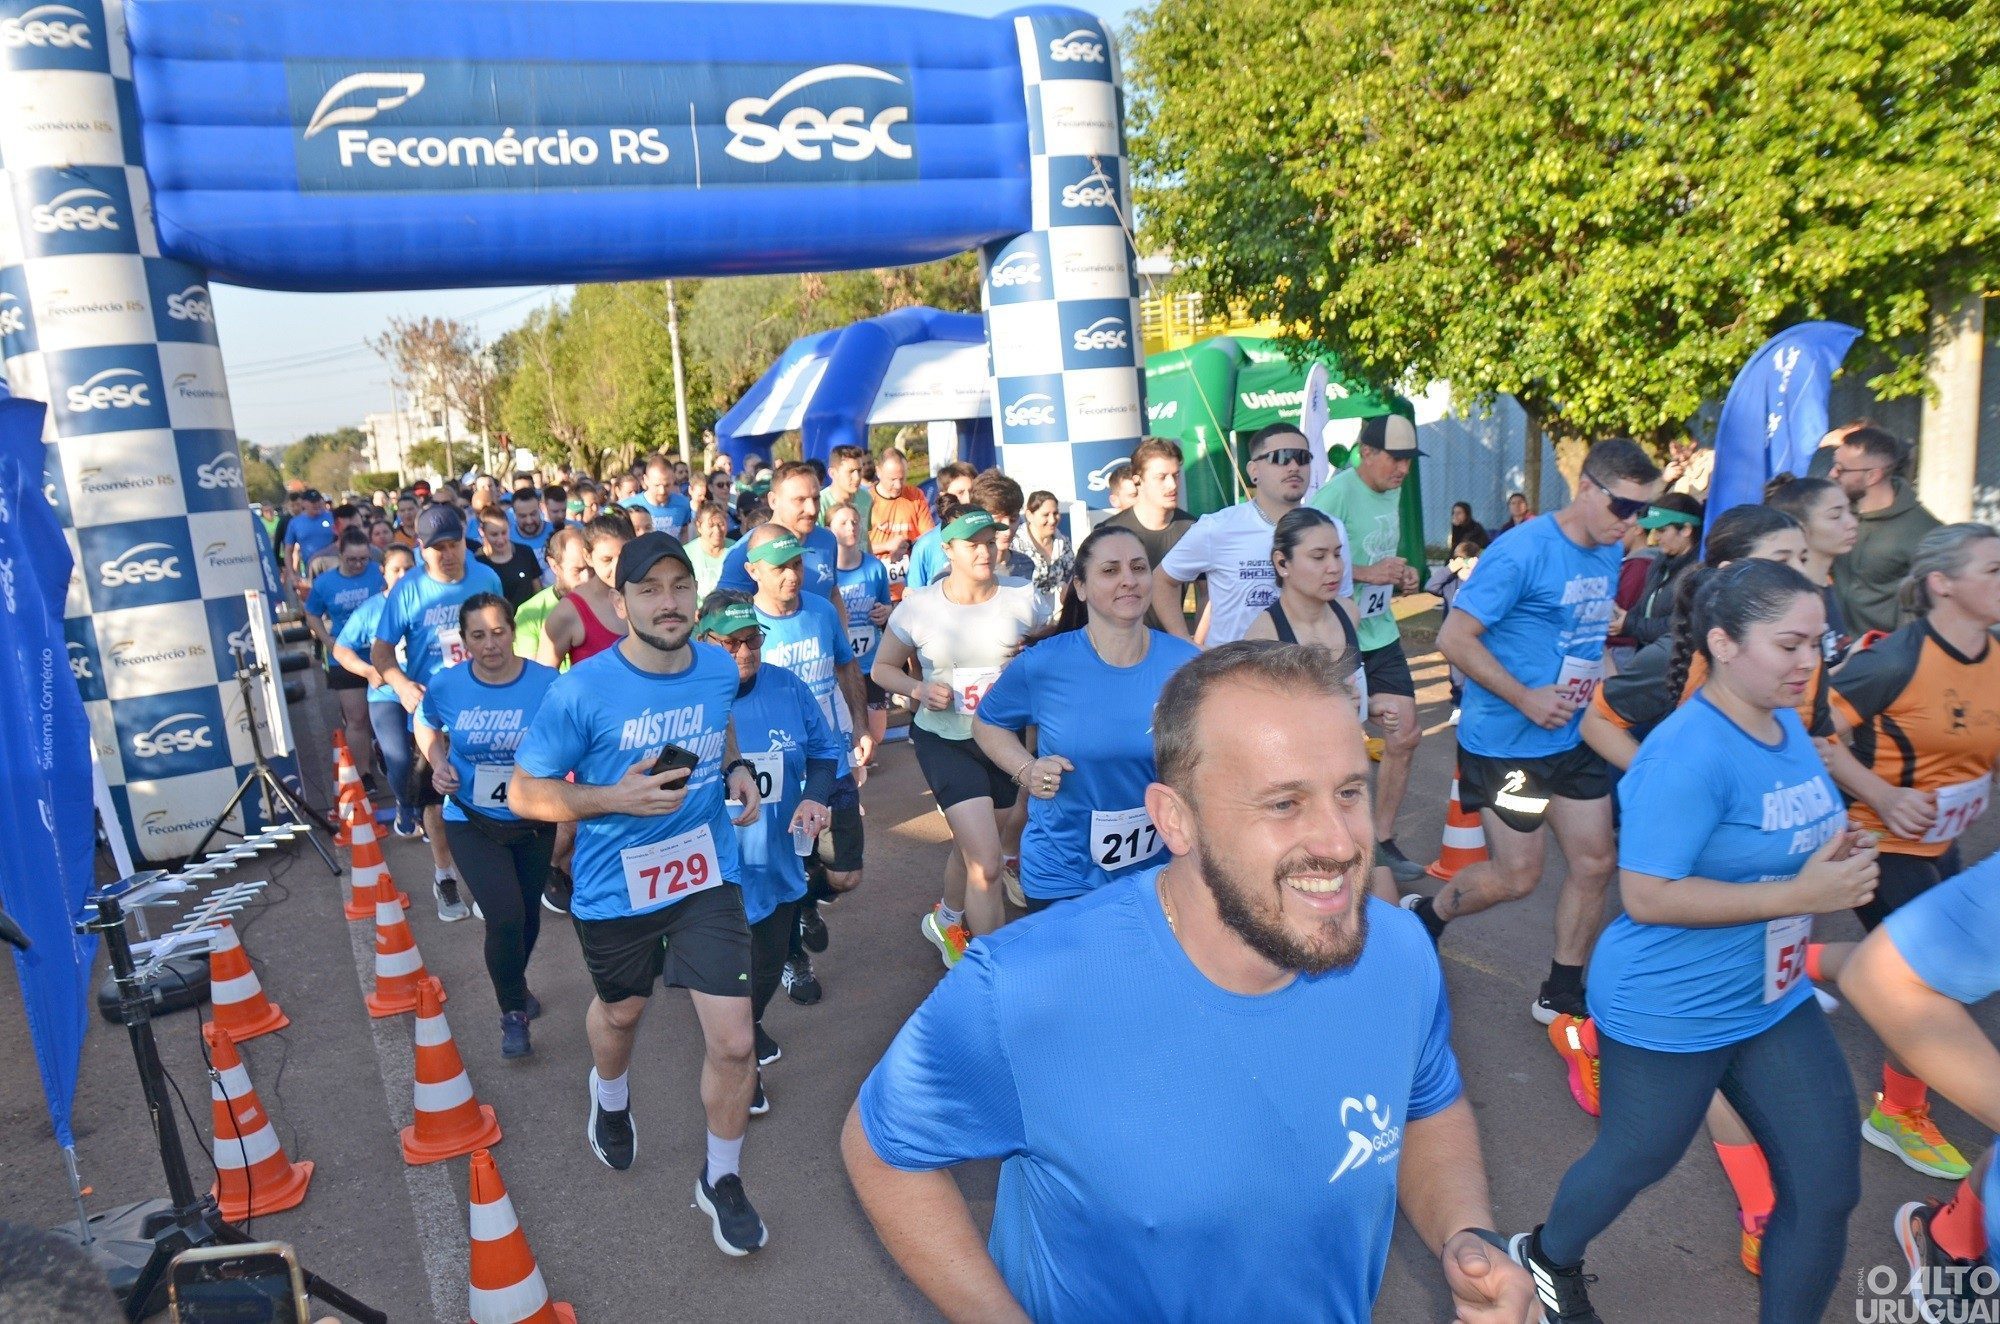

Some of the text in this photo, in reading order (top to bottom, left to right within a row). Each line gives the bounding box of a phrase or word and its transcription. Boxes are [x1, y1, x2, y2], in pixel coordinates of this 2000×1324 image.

[0, 19, 92, 49] Sesc
[1050, 38, 1105, 63] Sesc
[337, 95, 913, 167] Fecomércio RS Sesc
[32, 204, 119, 234] Sesc
[991, 262, 1042, 288] Sesc
[1073, 328, 1128, 351] Sesc
[66, 382, 151, 413] Sesc
[1004, 403, 1056, 427] Sesc
[99, 555, 182, 588] Sesc
[1366, 591, 1385, 614] 24
[114, 644, 207, 667] Fecomércio RS
[40, 647, 54, 771] Sistema Comércio
[455, 705, 524, 731] RÚSTICA
[132, 724, 214, 759] Sesc
[619, 703, 705, 751] RÚSTICA
[1100, 823, 1158, 865] 217
[638, 852, 709, 900] 729
[1372, 1126, 1400, 1151] GCOR
